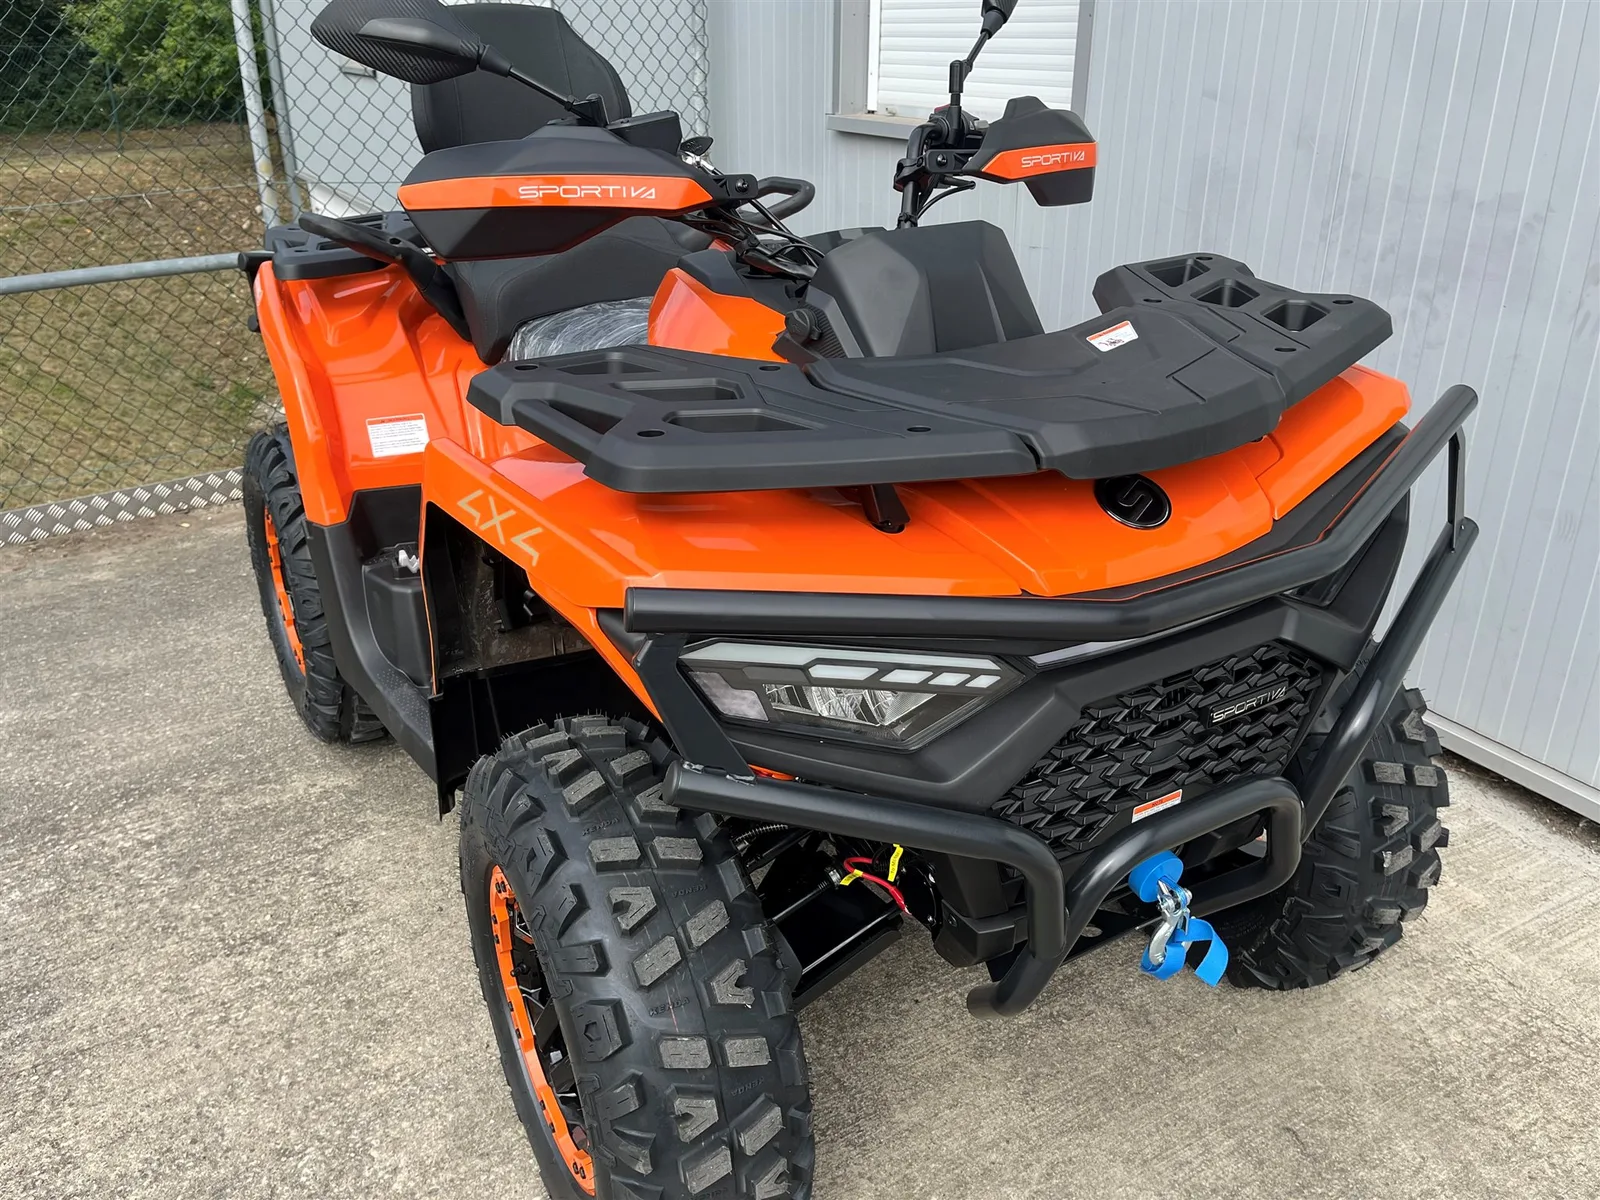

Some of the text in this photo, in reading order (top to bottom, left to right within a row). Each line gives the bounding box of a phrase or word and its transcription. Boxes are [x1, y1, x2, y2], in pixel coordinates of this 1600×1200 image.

[1021, 150, 1085, 168] SPORTIVA
[518, 185, 656, 199] SPORTIVA
[456, 488, 544, 567] 4X4
[1211, 686, 1286, 723] SPORTIVA
[582, 817, 620, 836] KENDA
[671, 883, 708, 898] KENDA
[648, 996, 690, 1017] KENDA
[730, 1076, 765, 1096] KENDA
